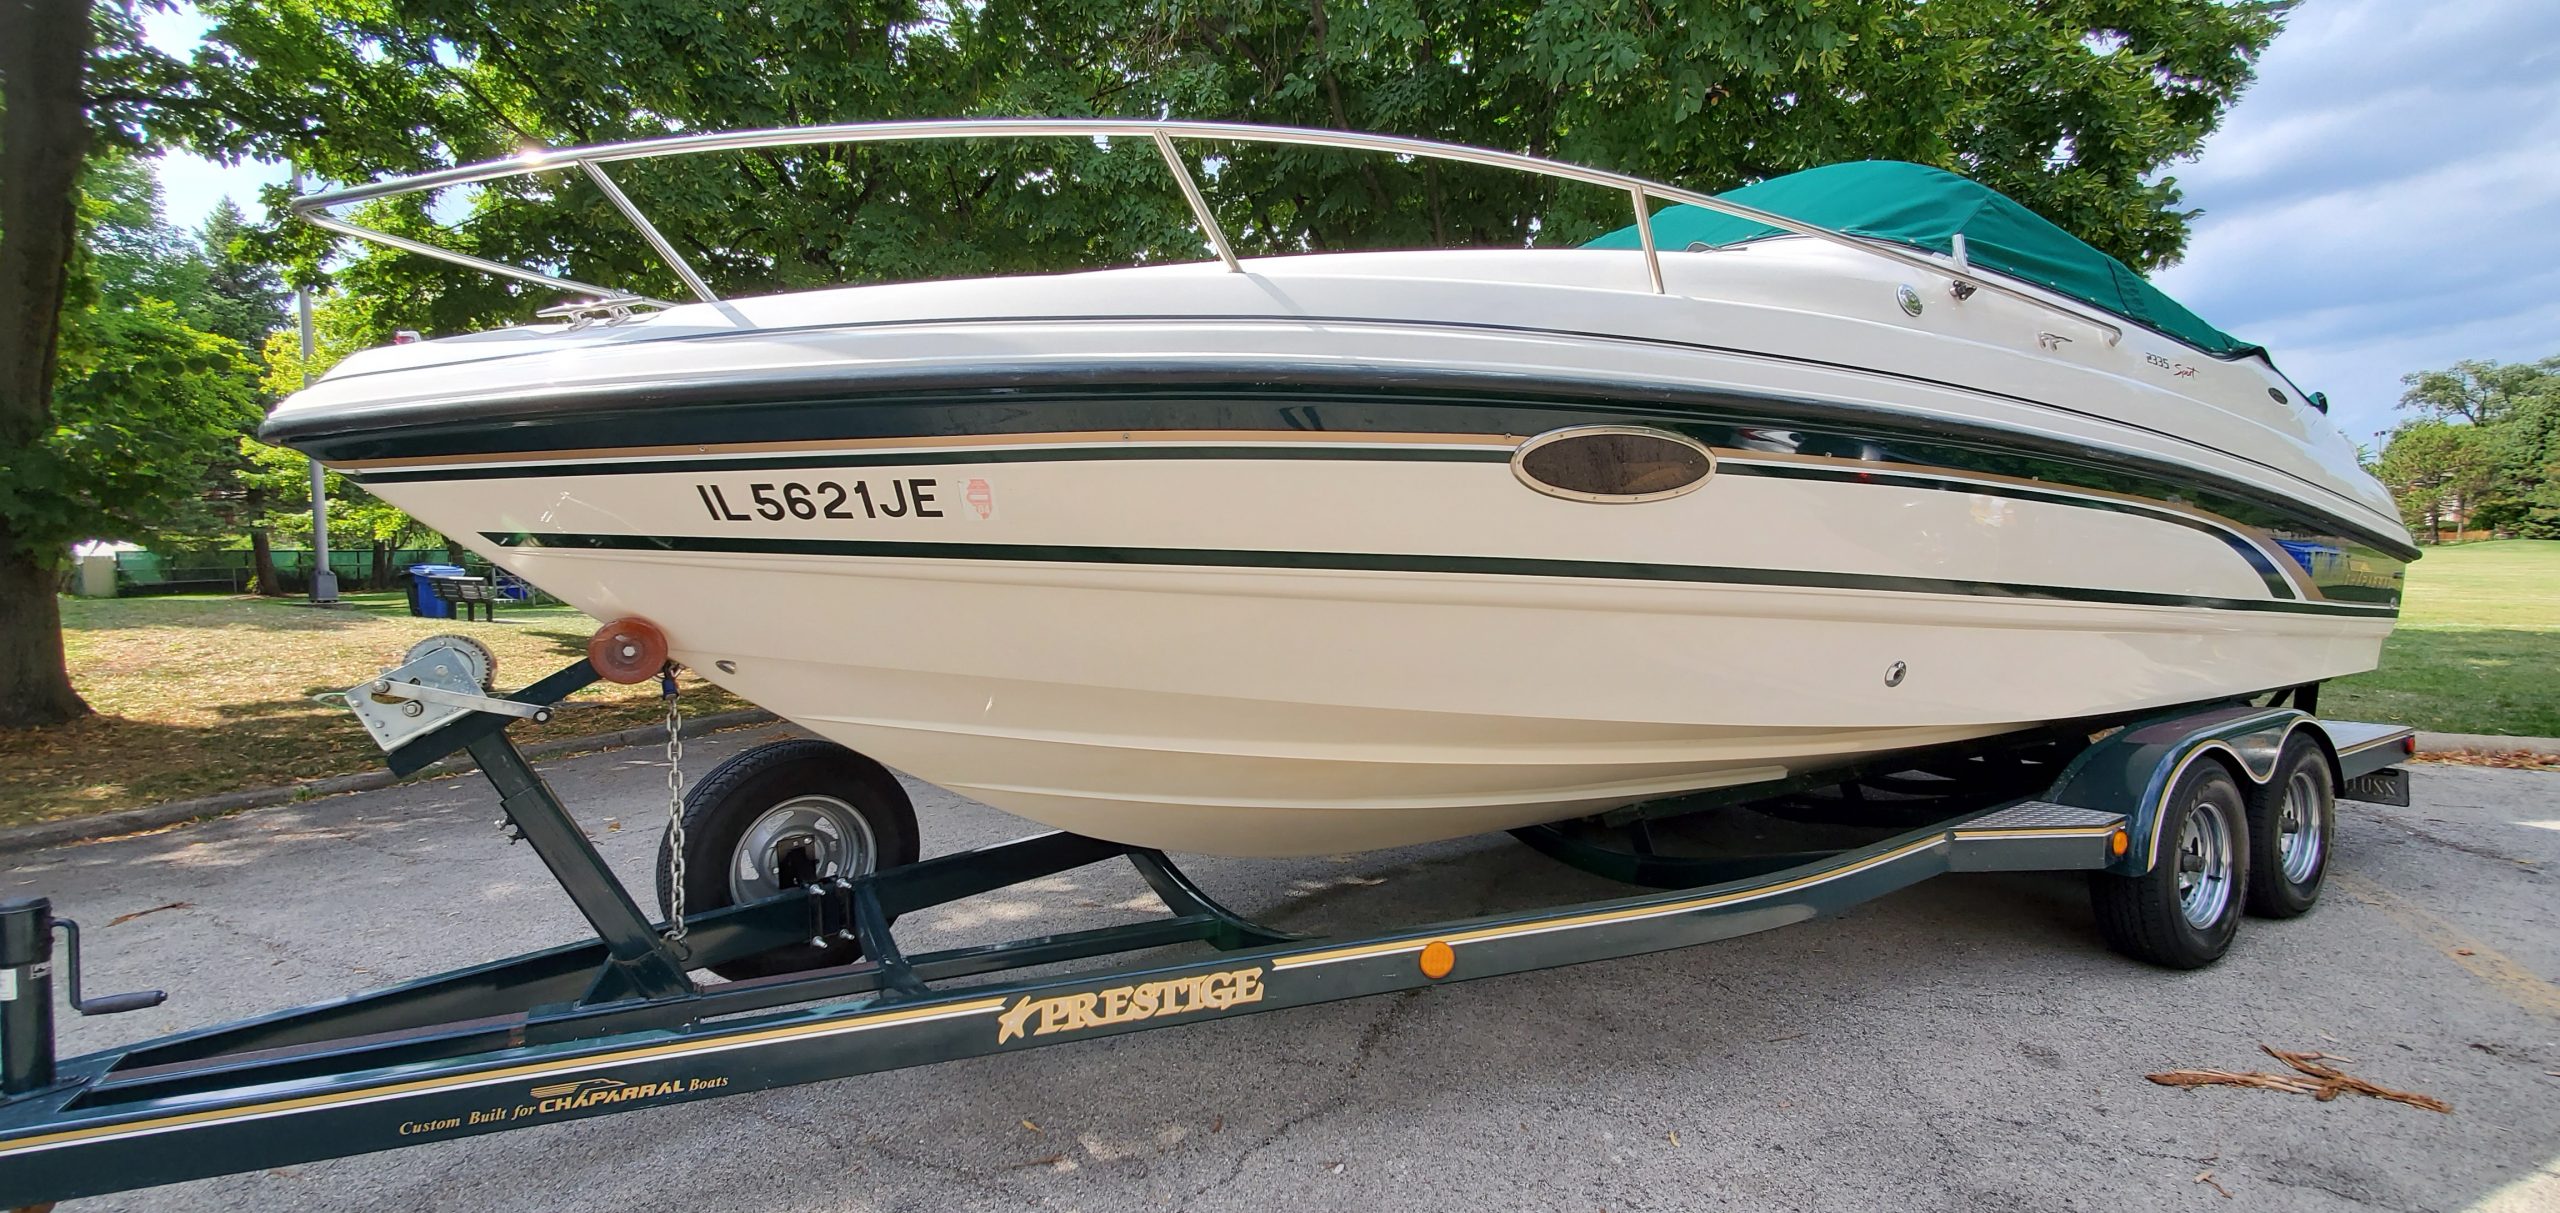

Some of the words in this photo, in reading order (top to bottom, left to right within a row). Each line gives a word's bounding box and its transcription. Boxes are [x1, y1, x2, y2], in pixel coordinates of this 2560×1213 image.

[2146, 352, 2170, 369] 2335
[2174, 363, 2200, 379] Sport
[696, 478, 944, 522] IL5621JE
[1033, 966, 1265, 1036] PRESTIGE
[399, 1116, 461, 1136] Custom
[468, 1107, 507, 1125] Built
[511, 1103, 537, 1121] for
[539, 1079, 685, 1114] CHAPARRAL
[690, 1075, 729, 1092] Boats
